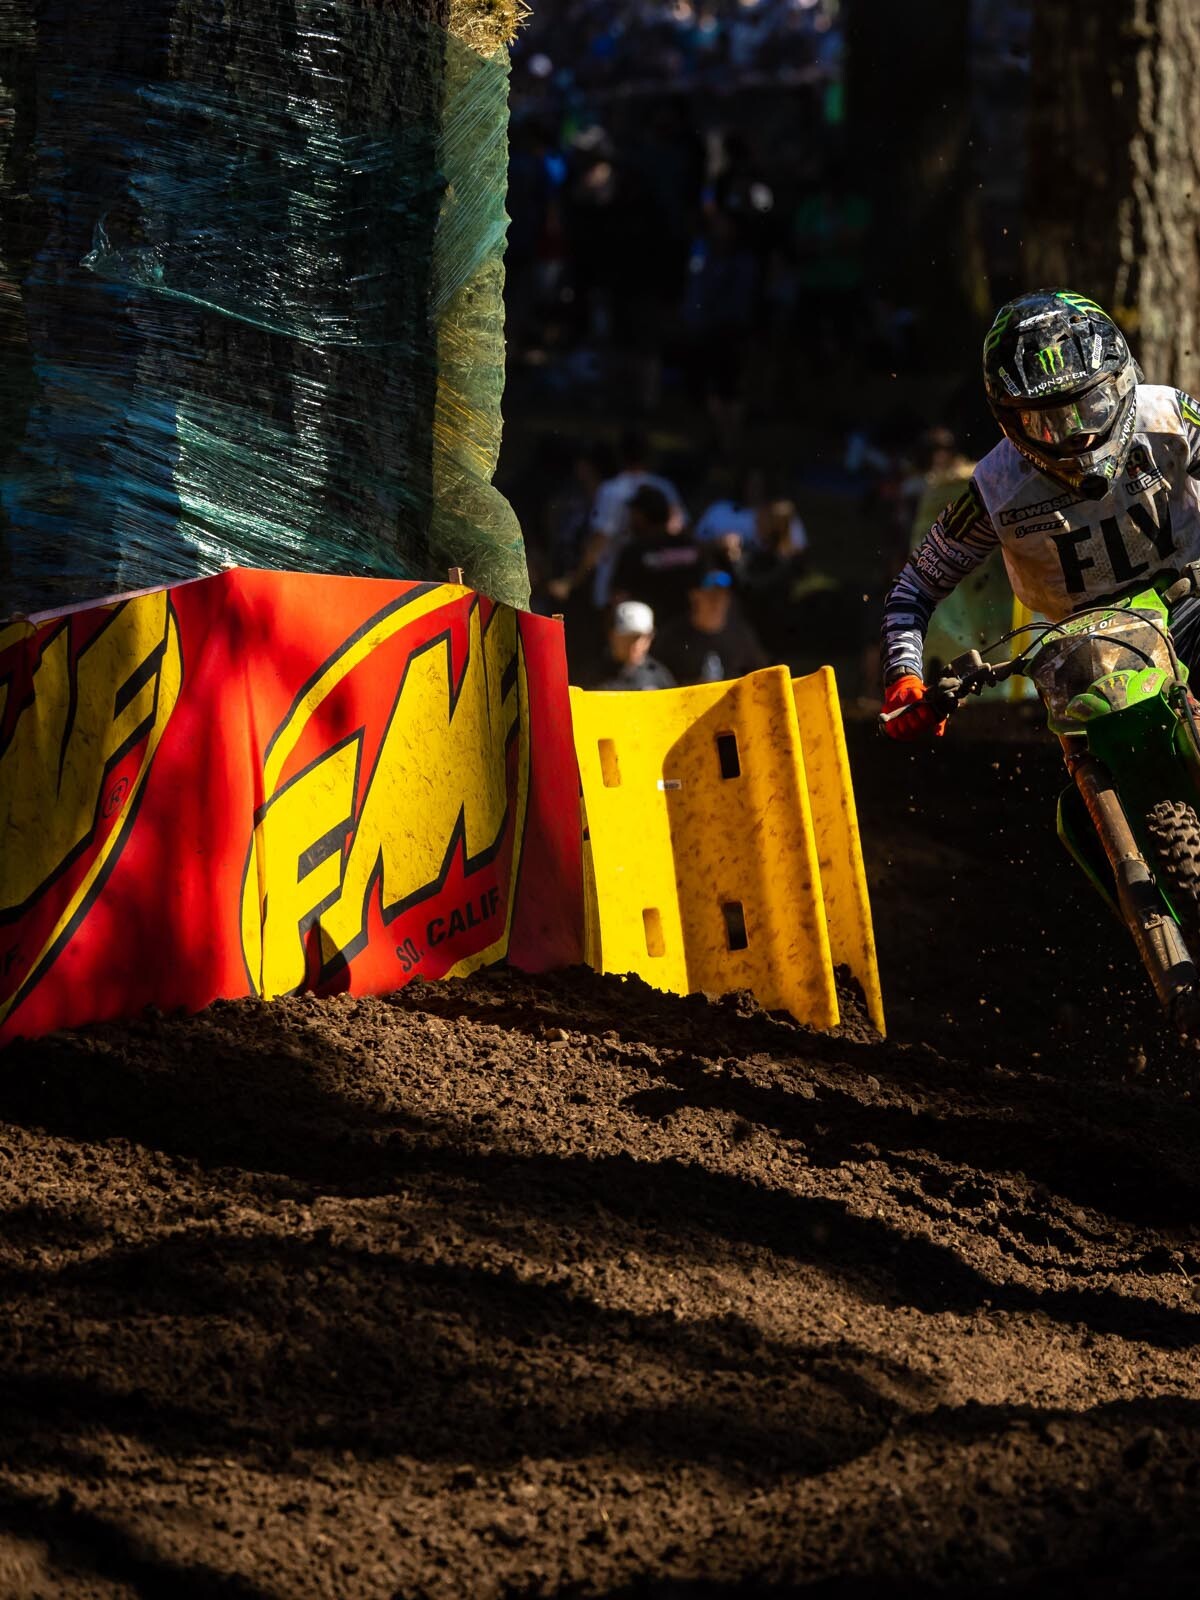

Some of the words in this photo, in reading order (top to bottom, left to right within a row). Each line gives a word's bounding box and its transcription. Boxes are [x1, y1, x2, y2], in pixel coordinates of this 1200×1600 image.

[999, 494, 1083, 527] Kawasa
[1050, 489, 1176, 593] FLY
[257, 592, 518, 1000] FMF
[396, 937, 425, 973] SO.
